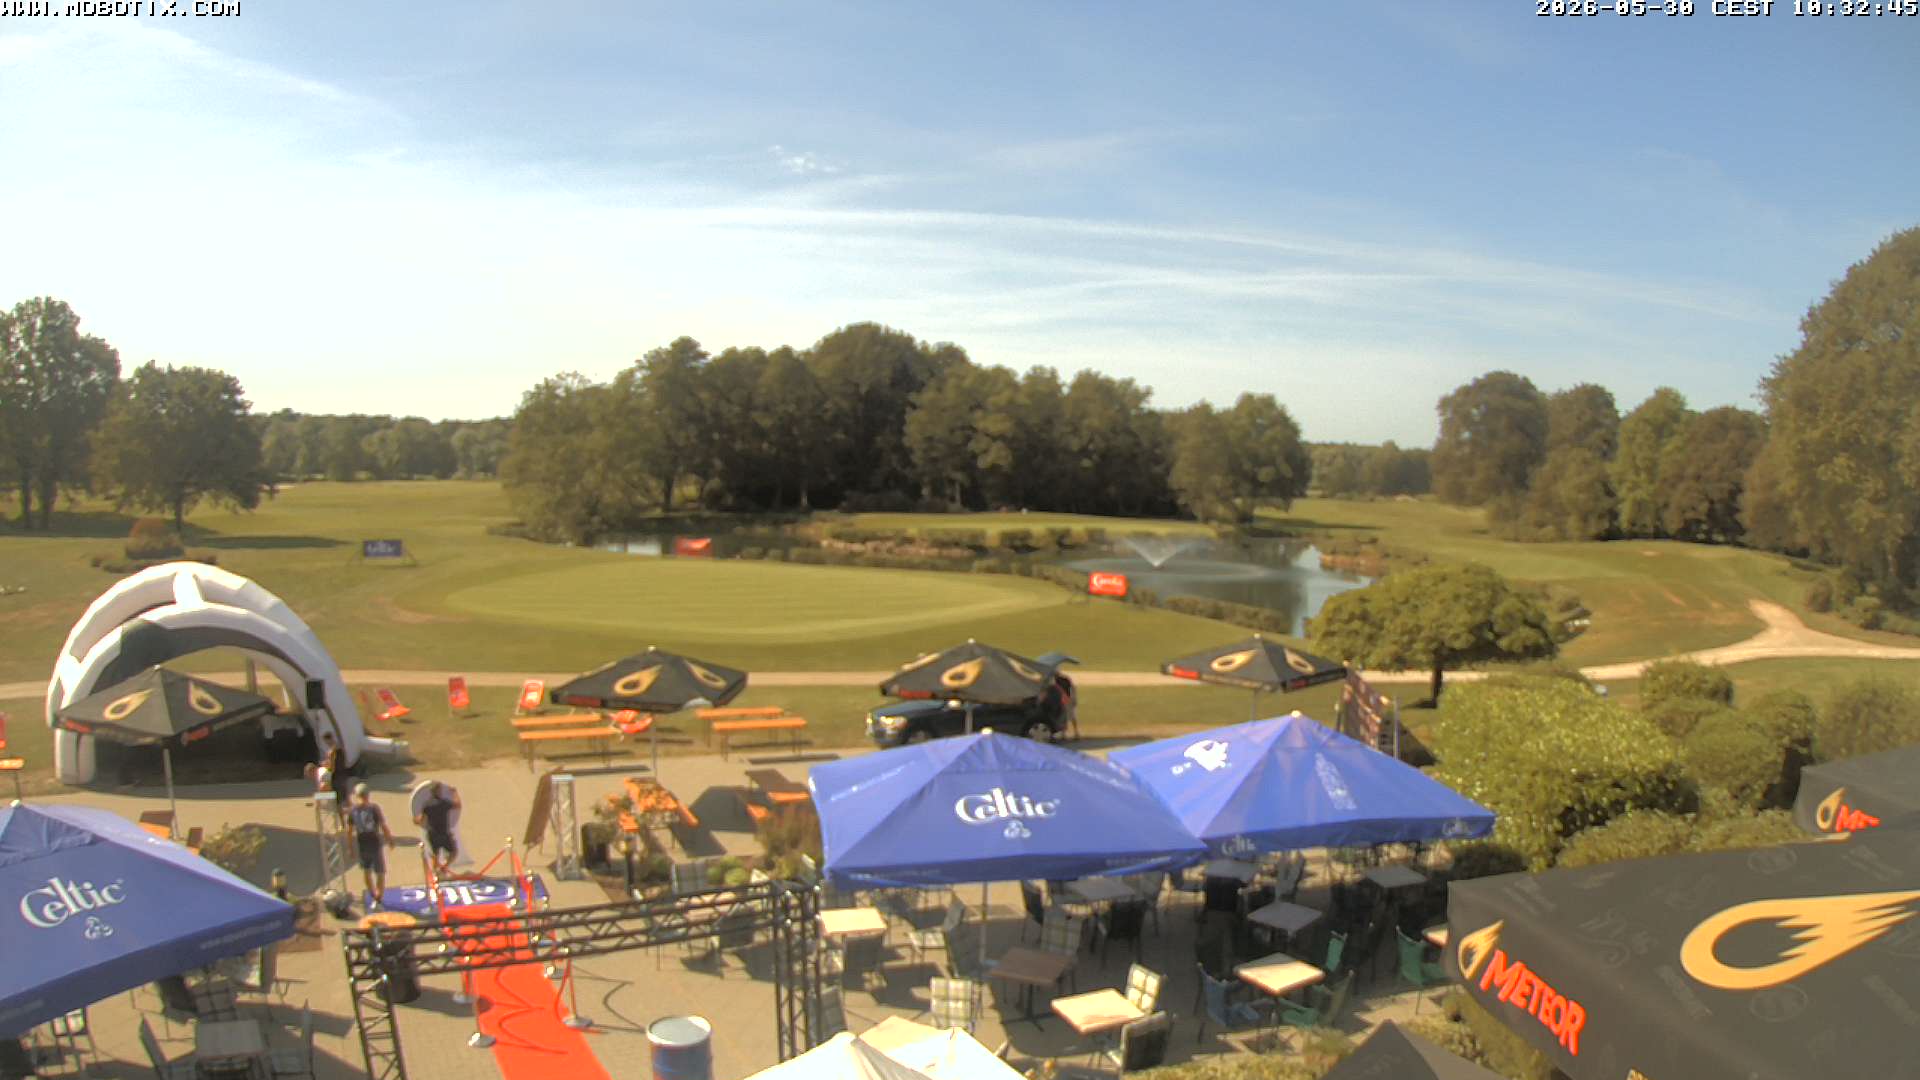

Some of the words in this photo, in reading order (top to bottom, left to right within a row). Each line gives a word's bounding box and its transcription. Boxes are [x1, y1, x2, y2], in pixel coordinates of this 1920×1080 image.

[954, 787, 1057, 822] Celtic
[20, 876, 127, 928] Celtic
[1479, 949, 1587, 1057] METEOR
